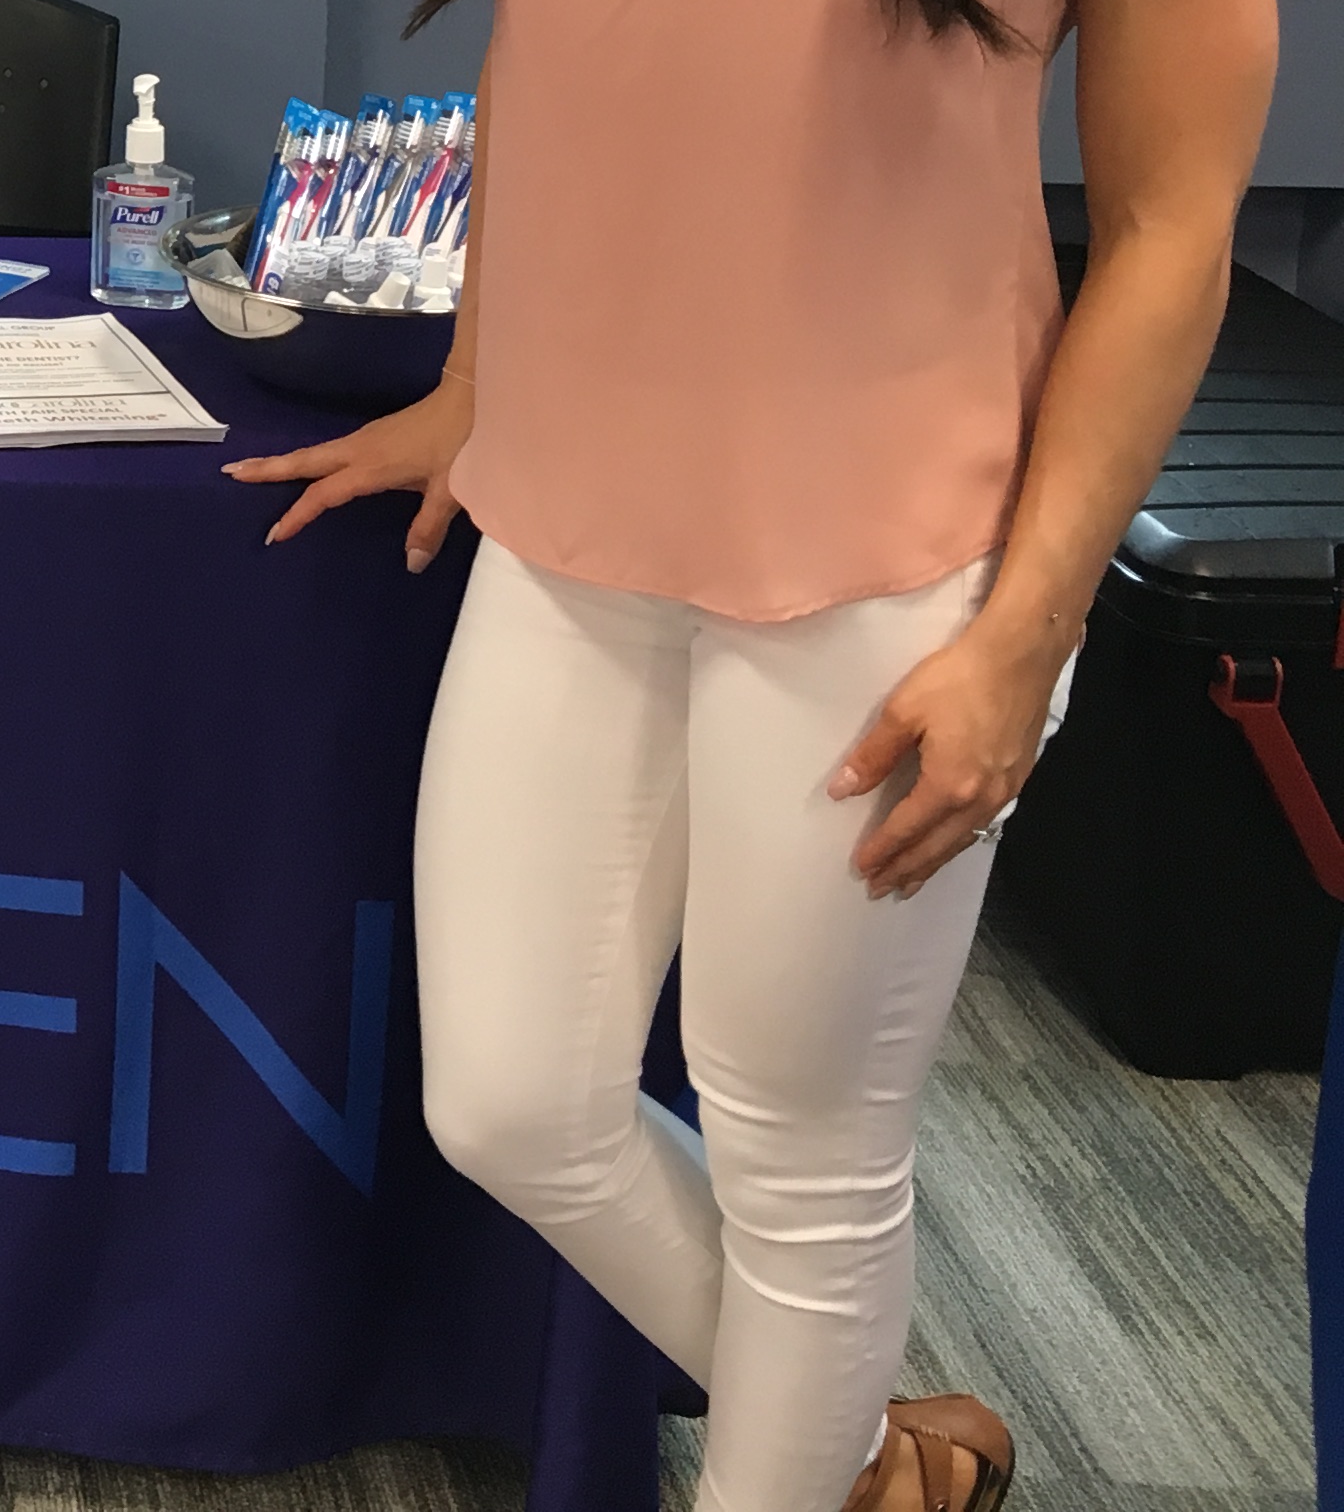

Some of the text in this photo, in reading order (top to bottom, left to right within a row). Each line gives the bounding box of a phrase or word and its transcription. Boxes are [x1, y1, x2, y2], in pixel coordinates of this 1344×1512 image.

[116, 206, 160, 224] Purell
[21, 408, 57, 416] FAIR
[60, 406, 121, 415] SPECIAL
